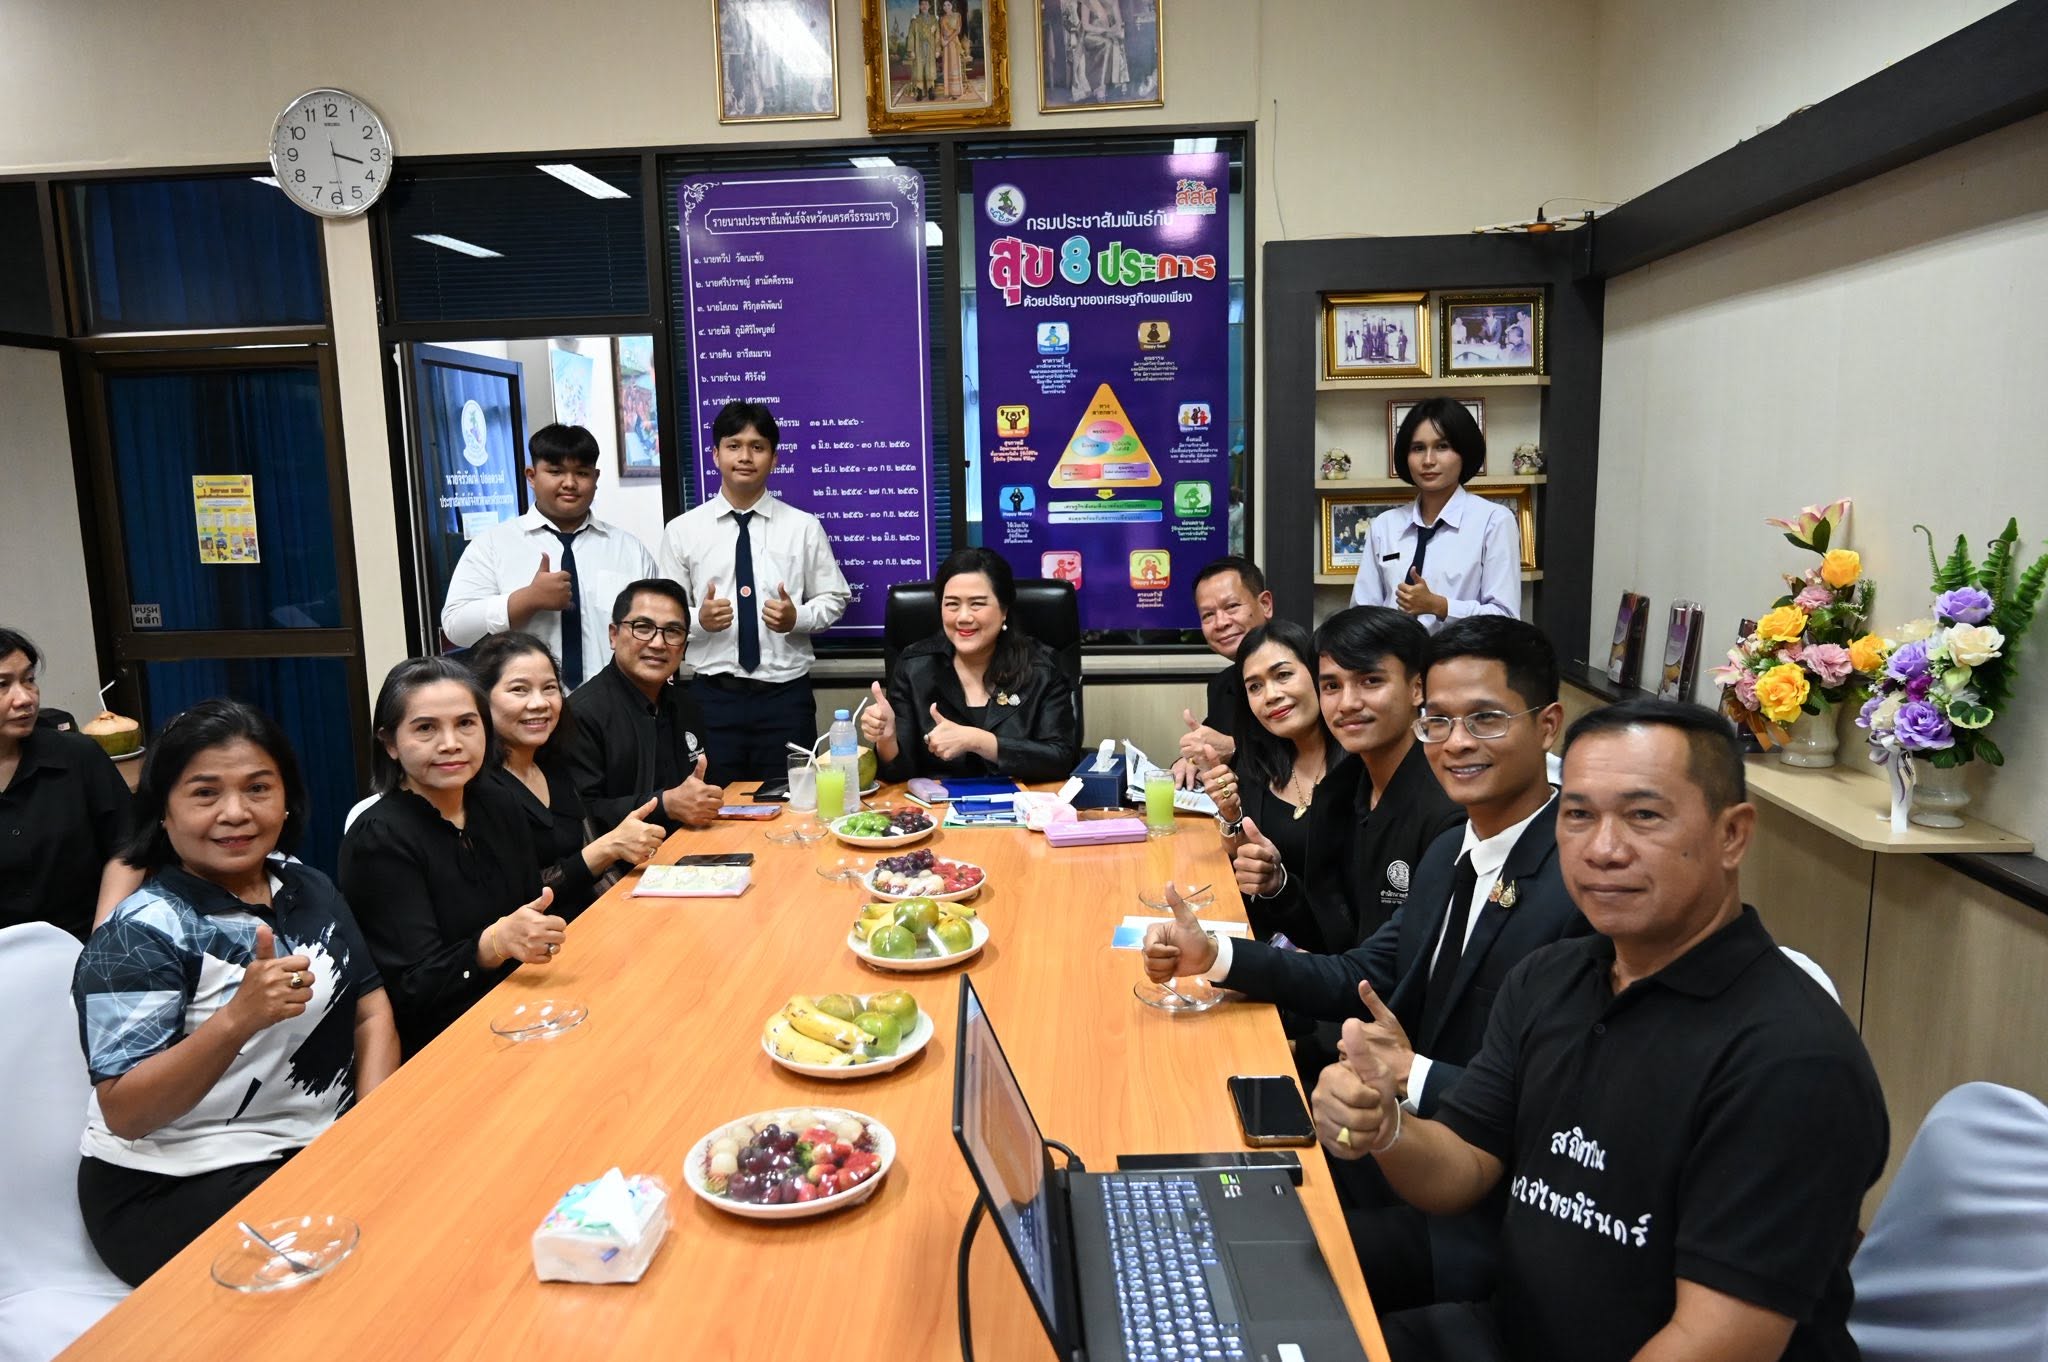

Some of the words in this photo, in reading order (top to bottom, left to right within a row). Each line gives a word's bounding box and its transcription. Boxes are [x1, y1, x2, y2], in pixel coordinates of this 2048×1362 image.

[305, 108, 316, 122] 11
[323, 103, 338, 118] 12
[350, 108, 355, 122] 1
[290, 126, 306, 140] 10
[362, 125, 373, 140] 2
[287, 147, 299, 162] 9
[370, 147, 381, 162] 3
[295, 169, 306, 183] 8
[365, 170, 375, 182] 4
[312, 186, 323, 199] 7
[331, 191, 343, 205] 6
[351, 186, 363, 199] 5
[712, 208, 891, 228] รายนามประชาสัมพันธ์จังหวัดนครศรีธรรมราช
[989, 235, 1054, 307] สุข
[1060, 234, 1091, 285] 8
[1098, 240, 1216, 286] ประการ
[1023, 292, 1193, 308] ด้วยปรัชญาของเศรษฐกิจพอเพียง
[134, 606, 158, 614] PUSH
[135, 613, 159, 625] ผลัก
